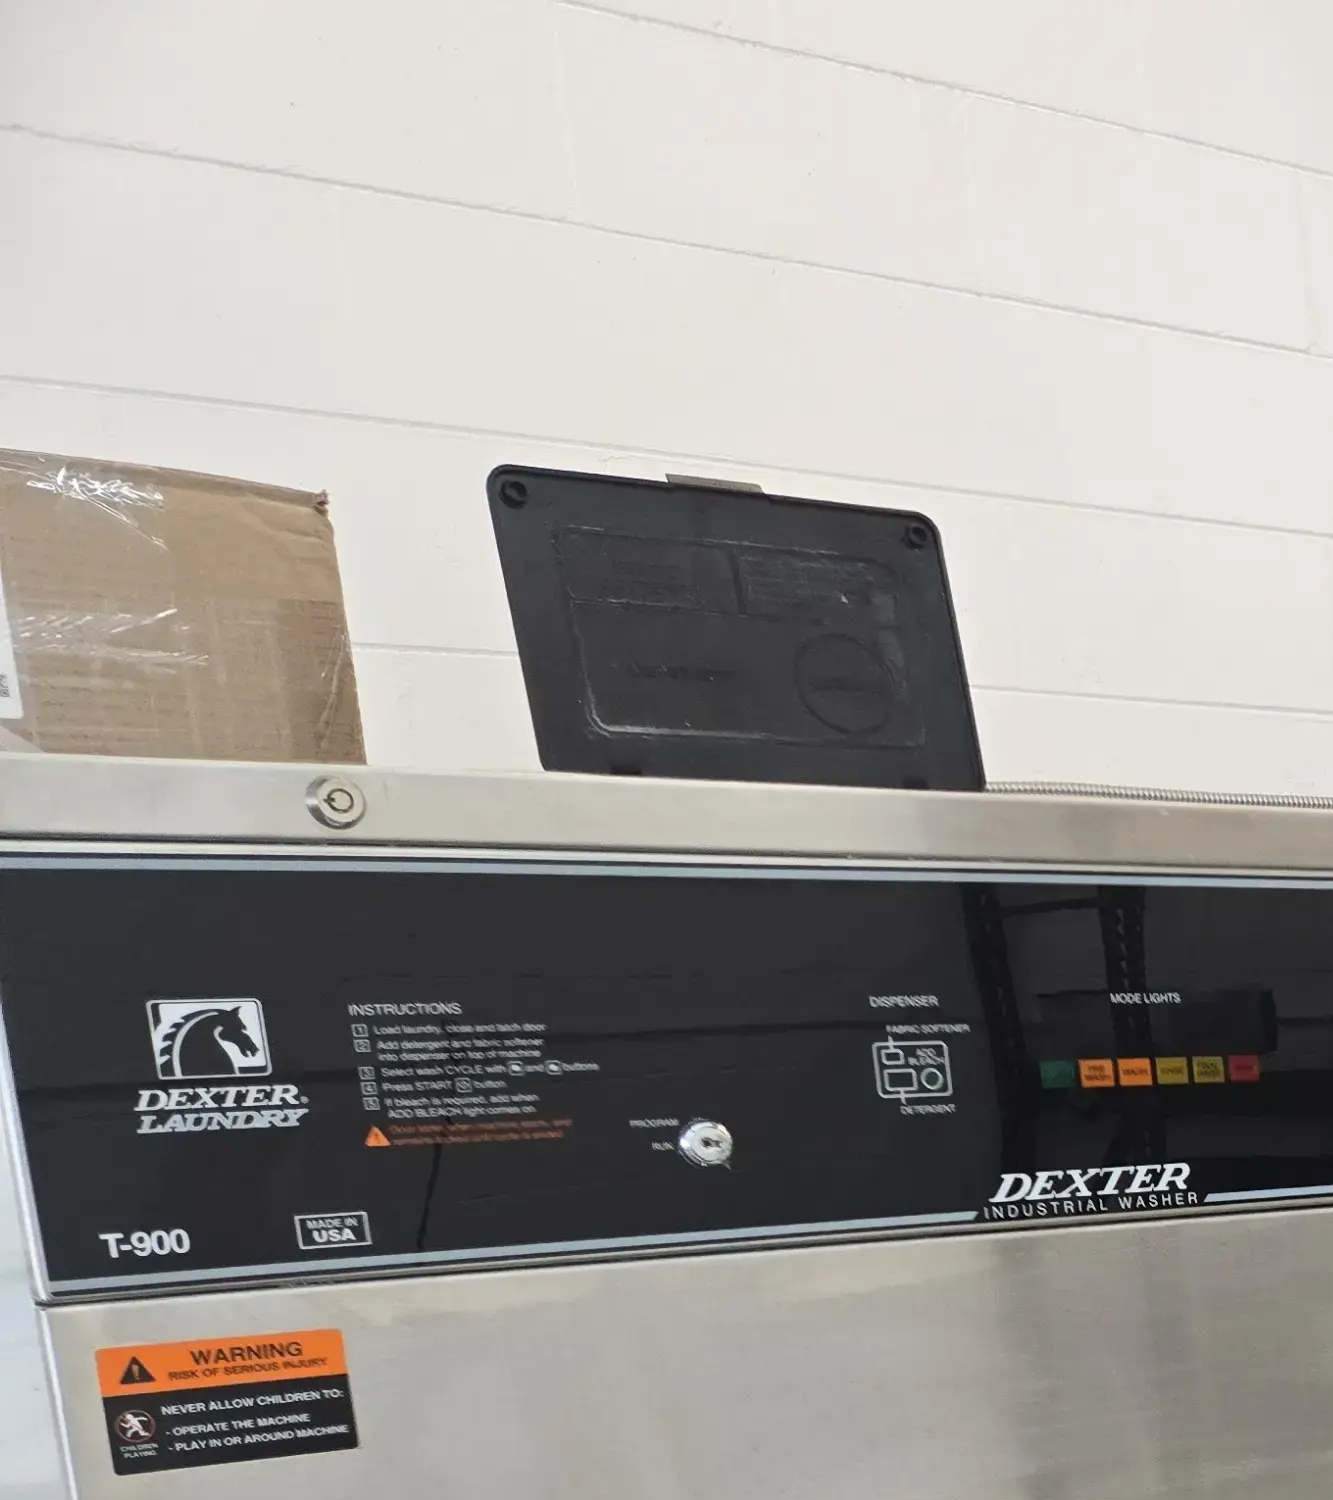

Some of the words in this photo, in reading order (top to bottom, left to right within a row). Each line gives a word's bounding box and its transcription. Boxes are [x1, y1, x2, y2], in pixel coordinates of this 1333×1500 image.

[347, 1001, 462, 1016] INSTRUCTIONS
[869, 995, 939, 1008] DISPENSER
[1109, 992, 1143, 1004] MODE
[1143, 992, 1182, 1004] LIGHTS
[445, 1064, 484, 1076] CYCLE
[414, 1080, 452, 1091] START
[134, 1084, 300, 1111] DEXTER
[137, 1108, 309, 1134] LAUNDRY
[988, 1162, 1191, 1203] DEXTER
[983, 1199, 1109, 1220] INDUSTRIAL
[1118, 1191, 1199, 1210] WASHER
[305, 1219, 342, 1230] MADE
[344, 1217, 359, 1227] IN
[99, 1228, 191, 1259] T-900
[311, 1228, 357, 1244] USA
[189, 1341, 303, 1366] WARNING
[168, 1369, 200, 1381] RISK
[201, 1367, 220, 1378] OF
[223, 1361, 279, 1376] SERIOUS
[282, 1357, 327, 1369] INJURY
[161, 1402, 206, 1415] NEVER
[208, 1397, 254, 1411] ALLOW
[256, 1391, 321, 1406] CHILDREN
[321, 1388, 344, 1398] TO:
[172, 1422, 230, 1436] OPERATE
[231, 1419, 255, 1429] THE
[256, 1413, 311, 1427] MACHINE
[120, 1443, 159, 1452] CHILDREN
[174, 1439, 207, 1451] PLAY
[208, 1438, 222, 1448] IN
[223, 1436, 242, 1446] OR
[244, 1430, 295, 1444] AROUND
[295, 1424, 349, 1438] MACHINE
